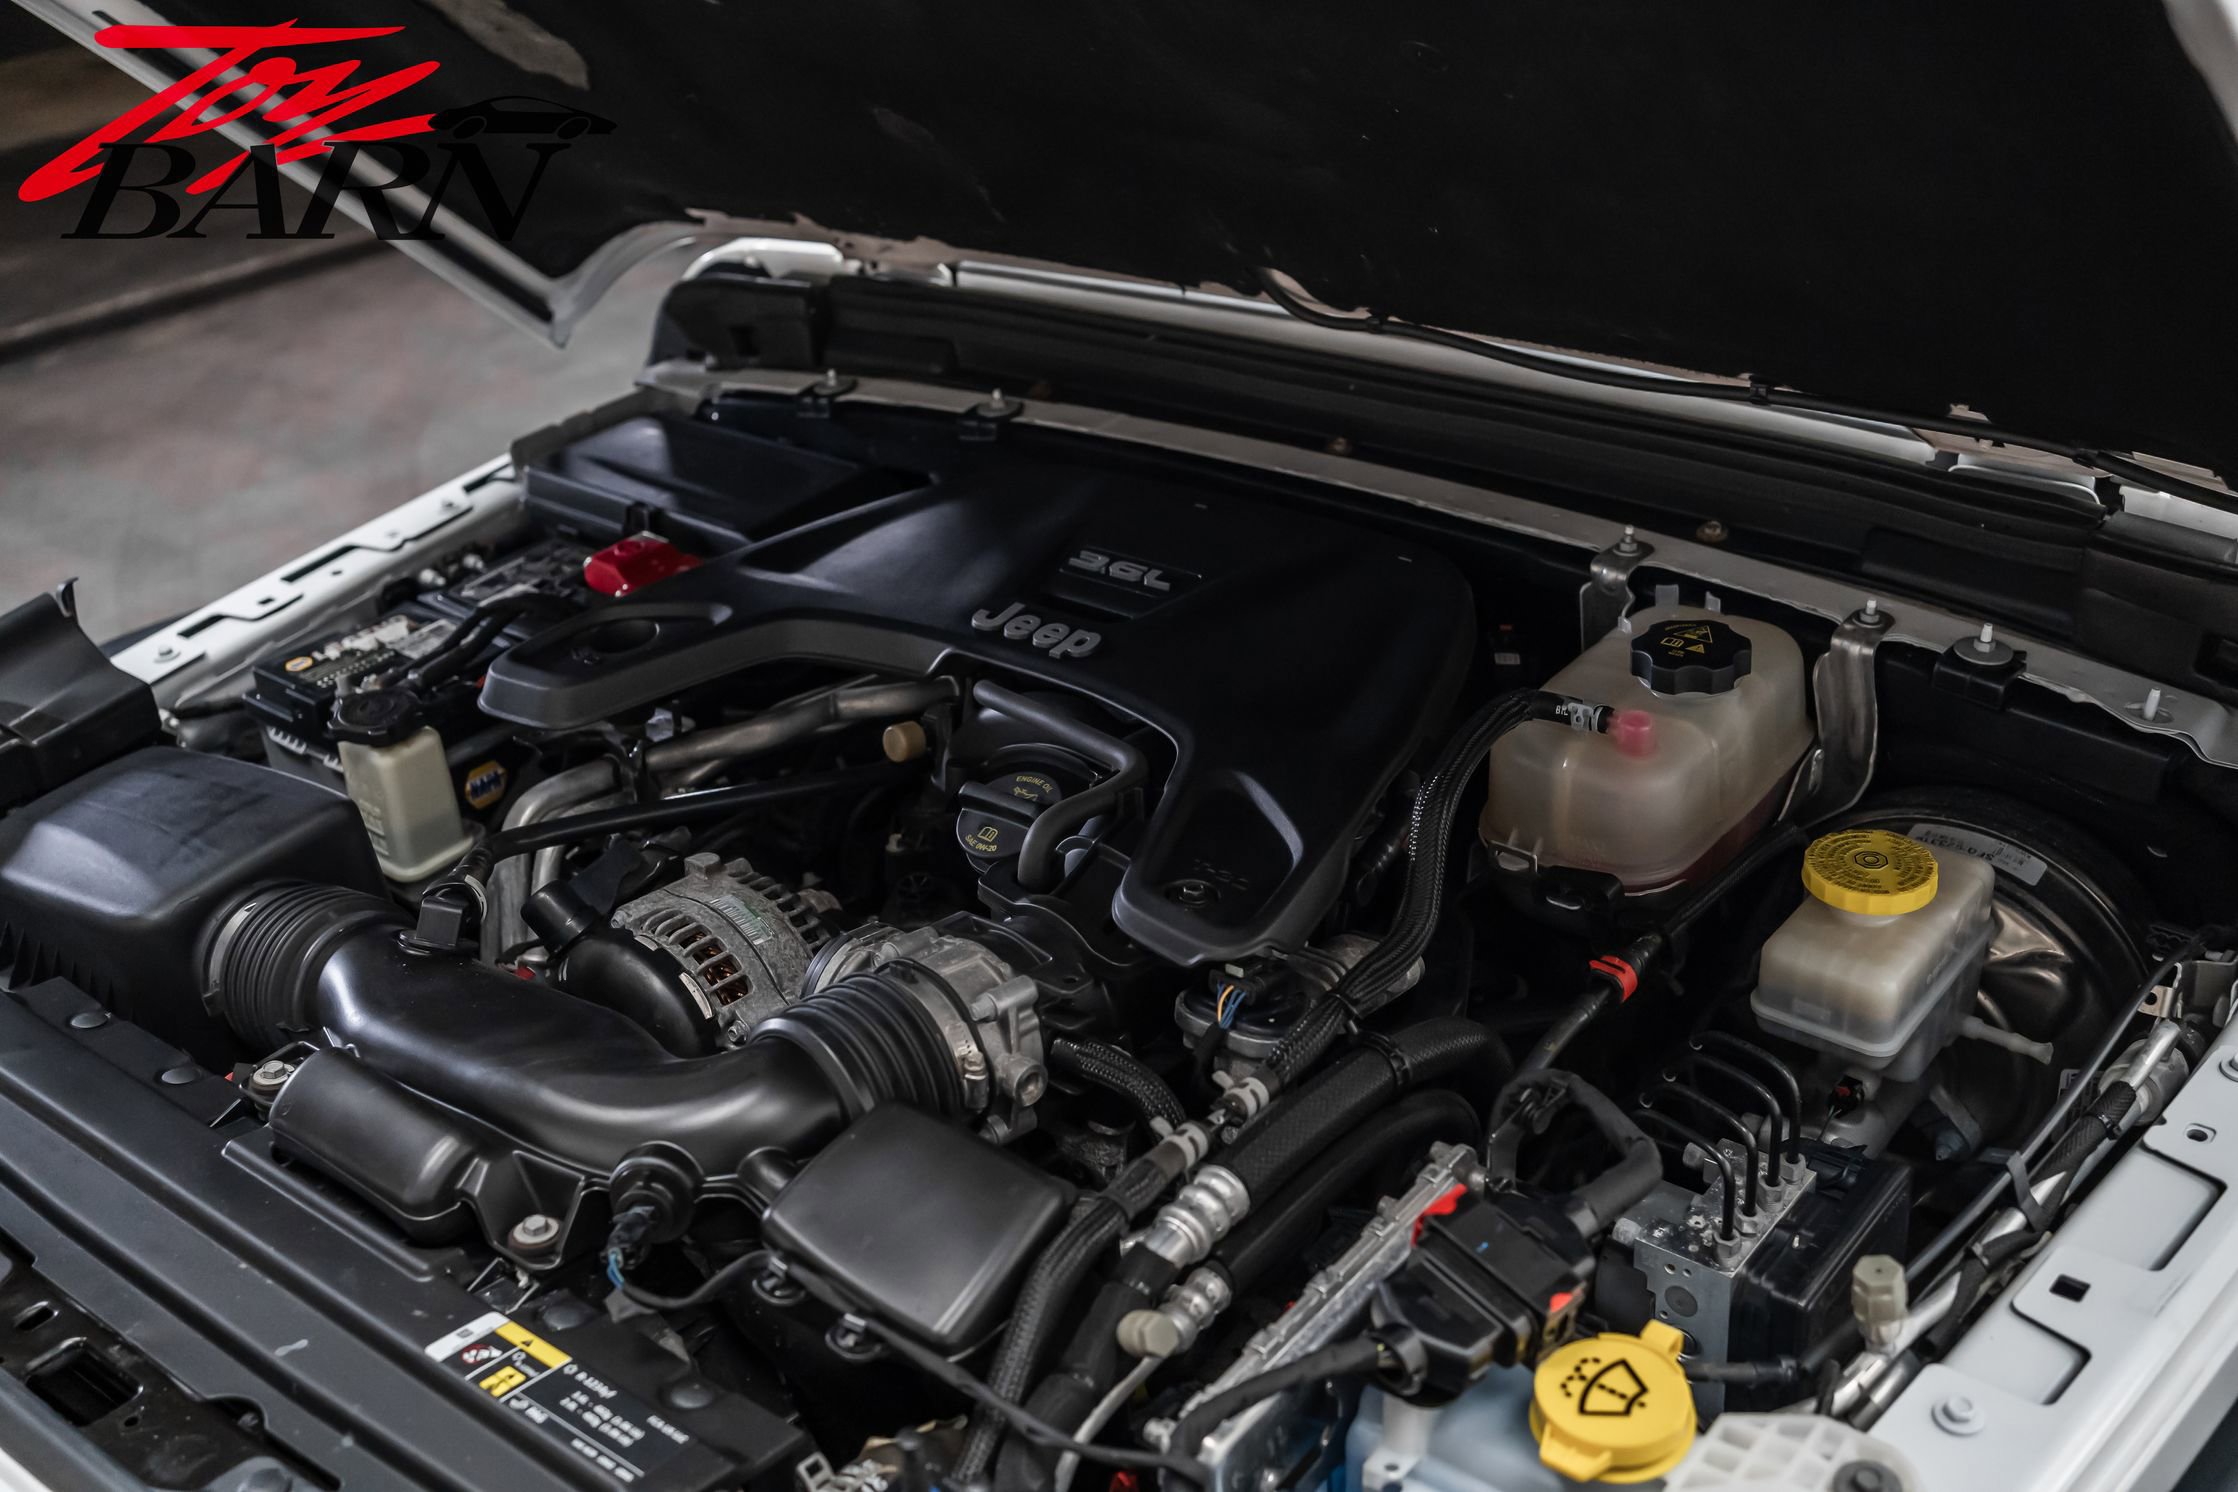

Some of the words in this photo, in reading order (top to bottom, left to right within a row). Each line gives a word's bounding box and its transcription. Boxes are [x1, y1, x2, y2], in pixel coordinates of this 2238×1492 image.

[971, 602, 1102, 660] Jeep
[1016, 775, 1045, 786] ENGINE
[965, 834, 978, 847] SAE
